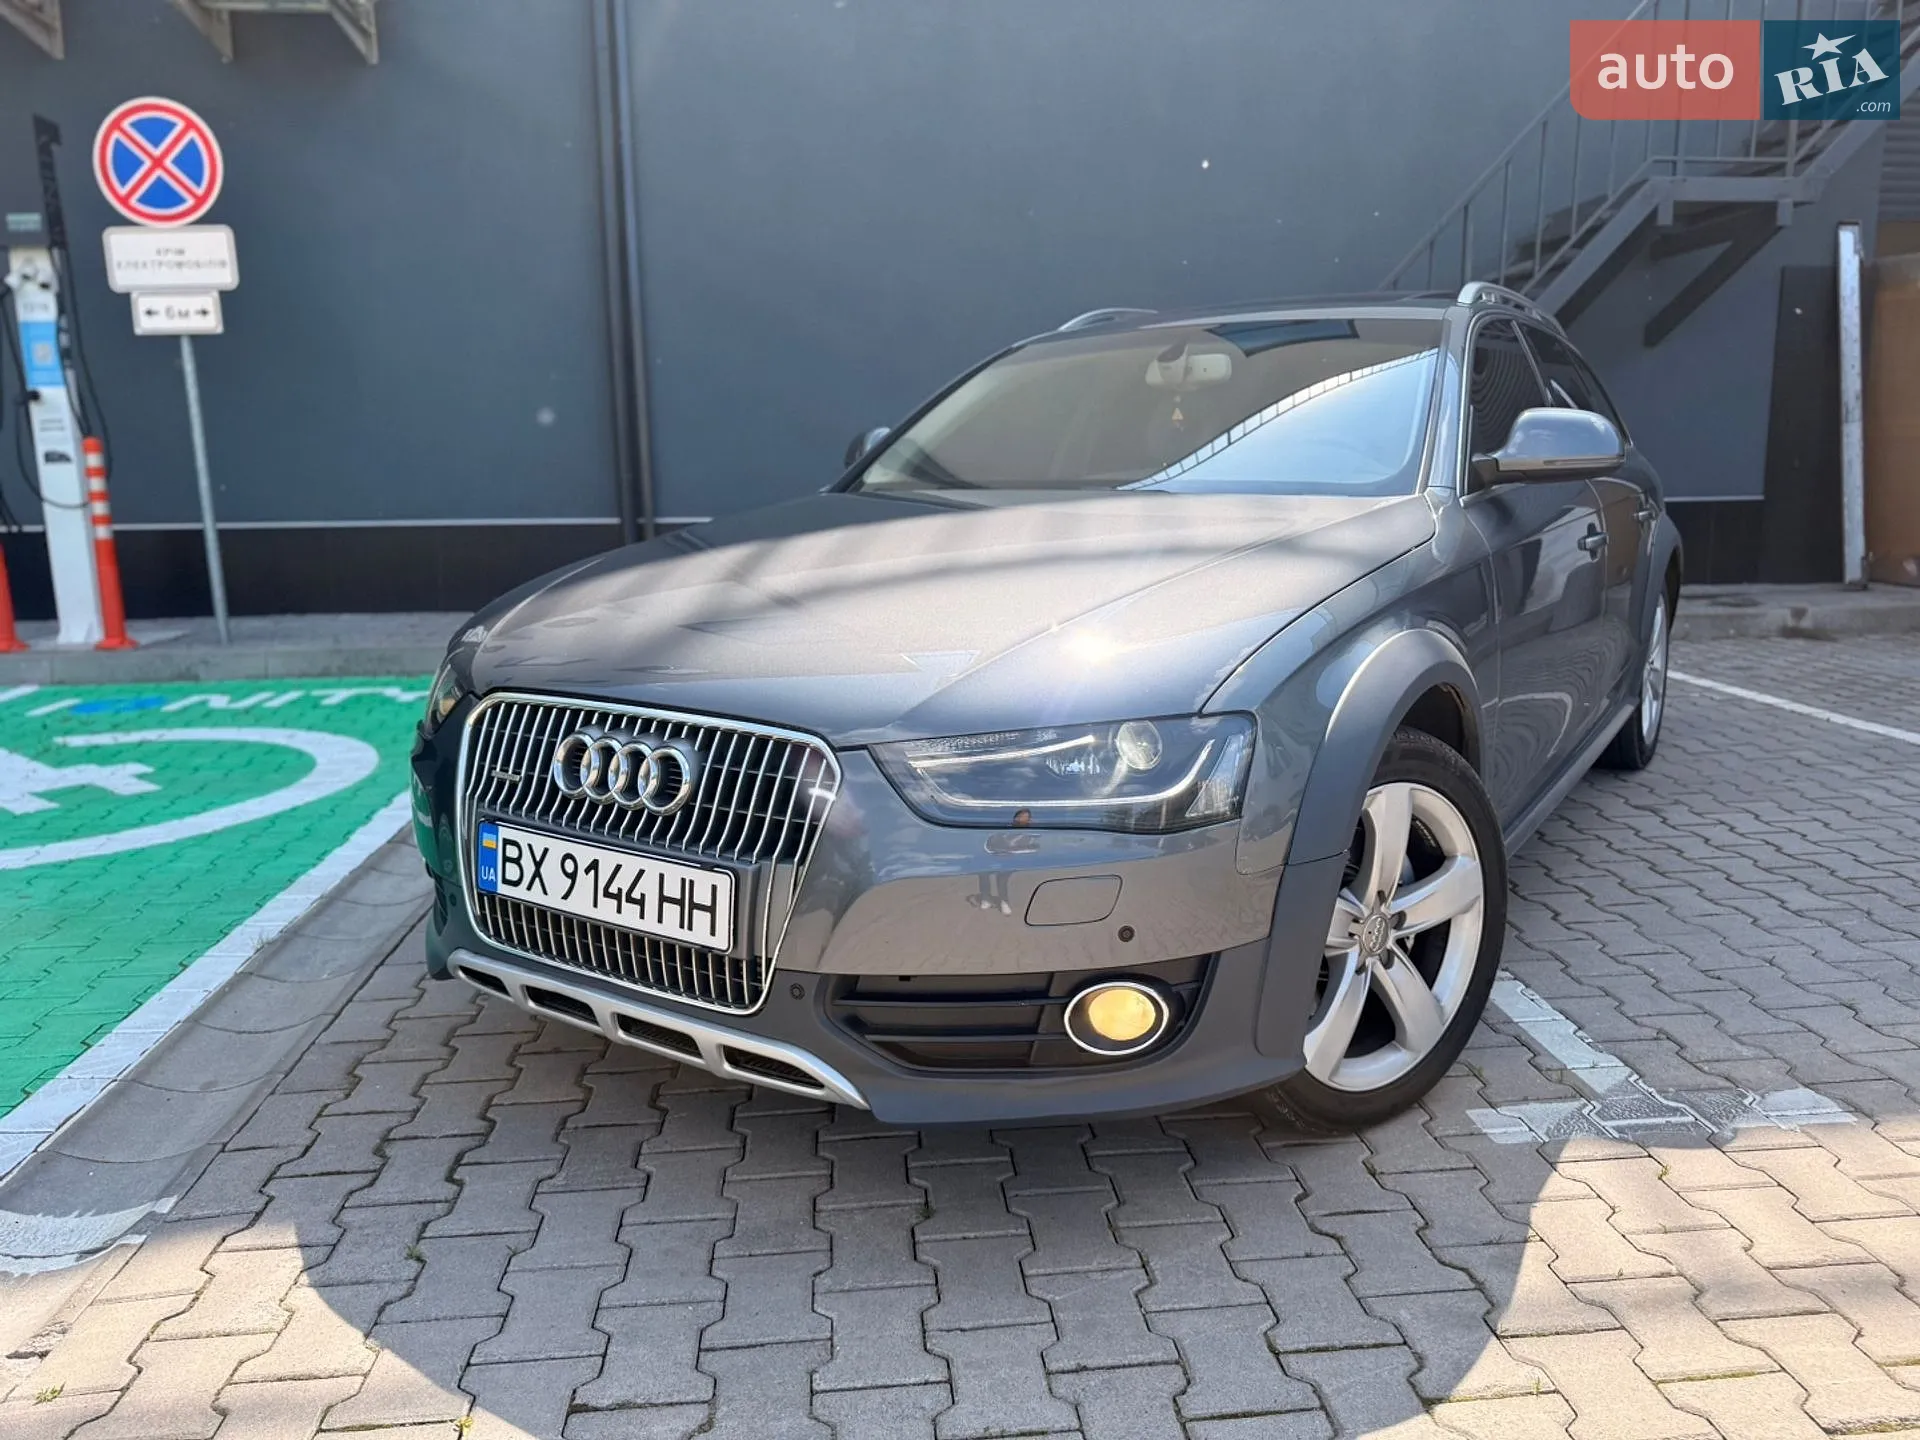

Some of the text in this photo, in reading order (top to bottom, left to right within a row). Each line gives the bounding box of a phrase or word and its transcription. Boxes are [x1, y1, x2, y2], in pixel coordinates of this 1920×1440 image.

[481, 865, 497, 883] UA
[502, 837, 718, 937] BX 9144 HH
